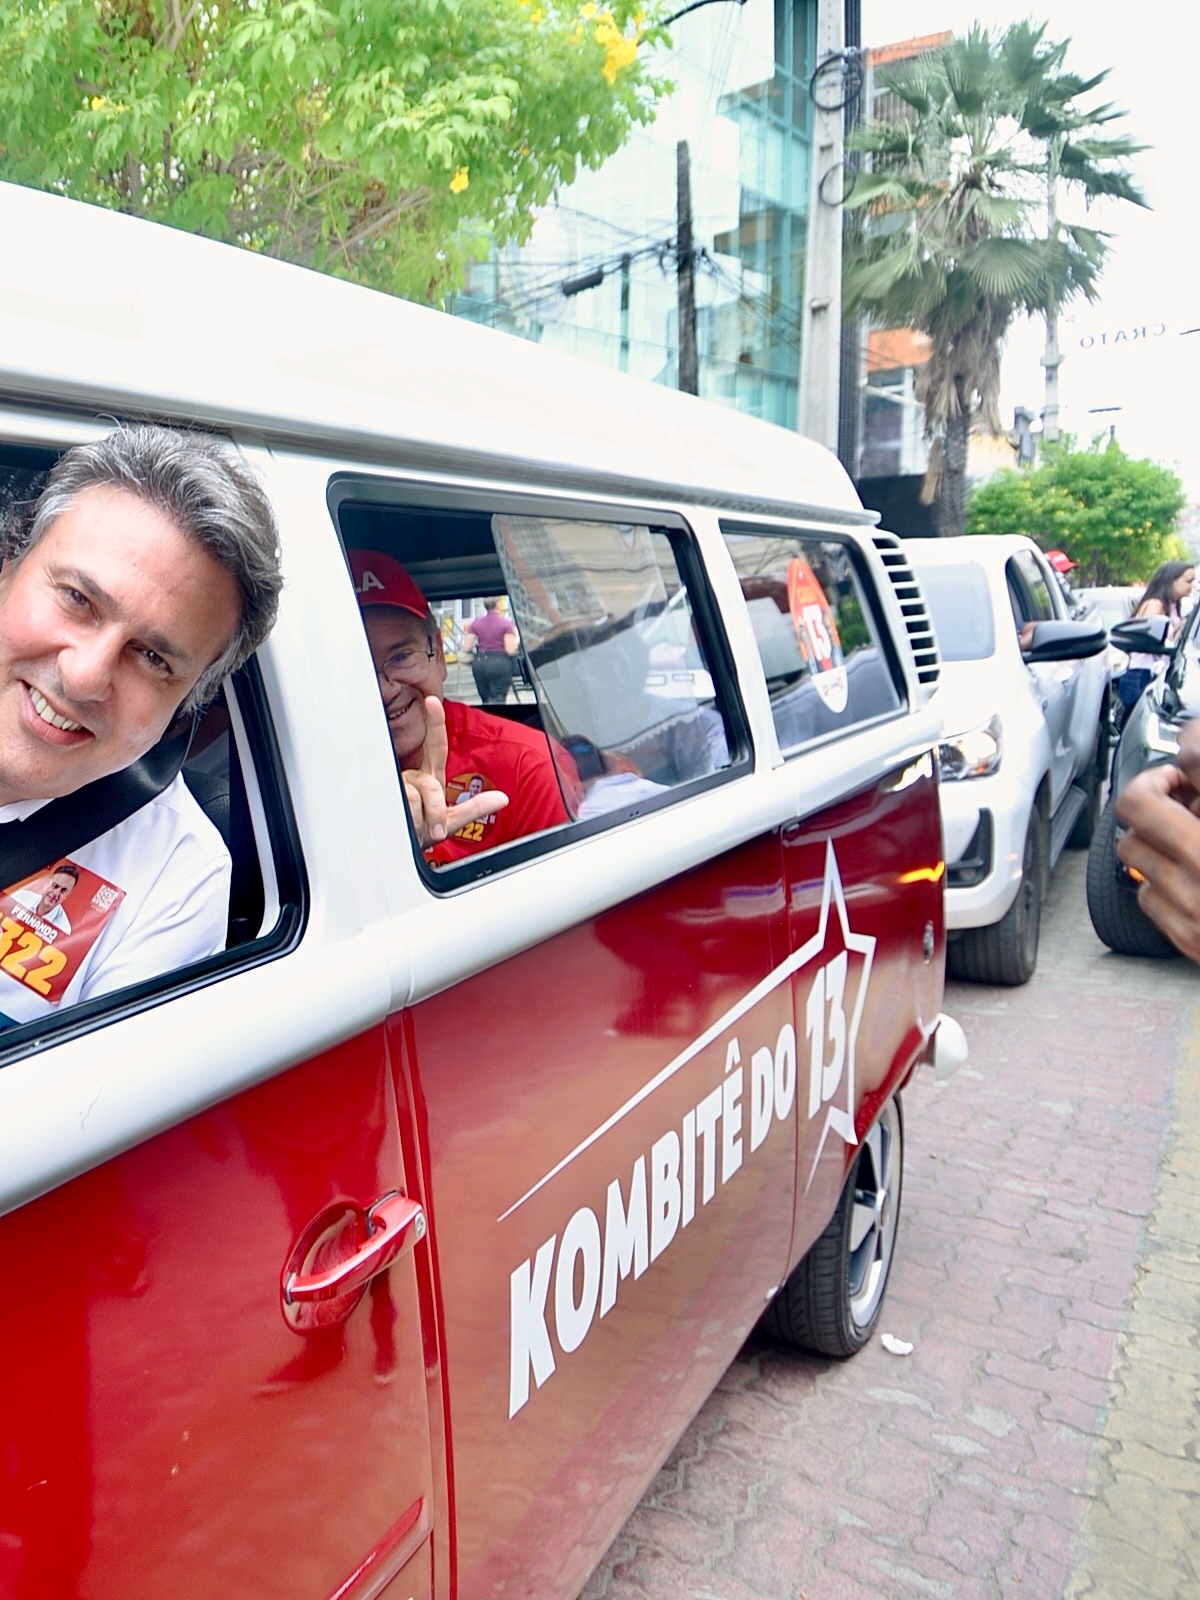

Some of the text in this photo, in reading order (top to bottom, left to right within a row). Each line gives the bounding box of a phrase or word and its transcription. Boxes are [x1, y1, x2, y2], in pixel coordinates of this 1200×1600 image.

[802, 604, 832, 662] 13
[454, 821, 485, 842] 22
[11, 905, 58, 941] FERNANDO
[509, 949, 848, 1420] KOMBITÊ DO 13
